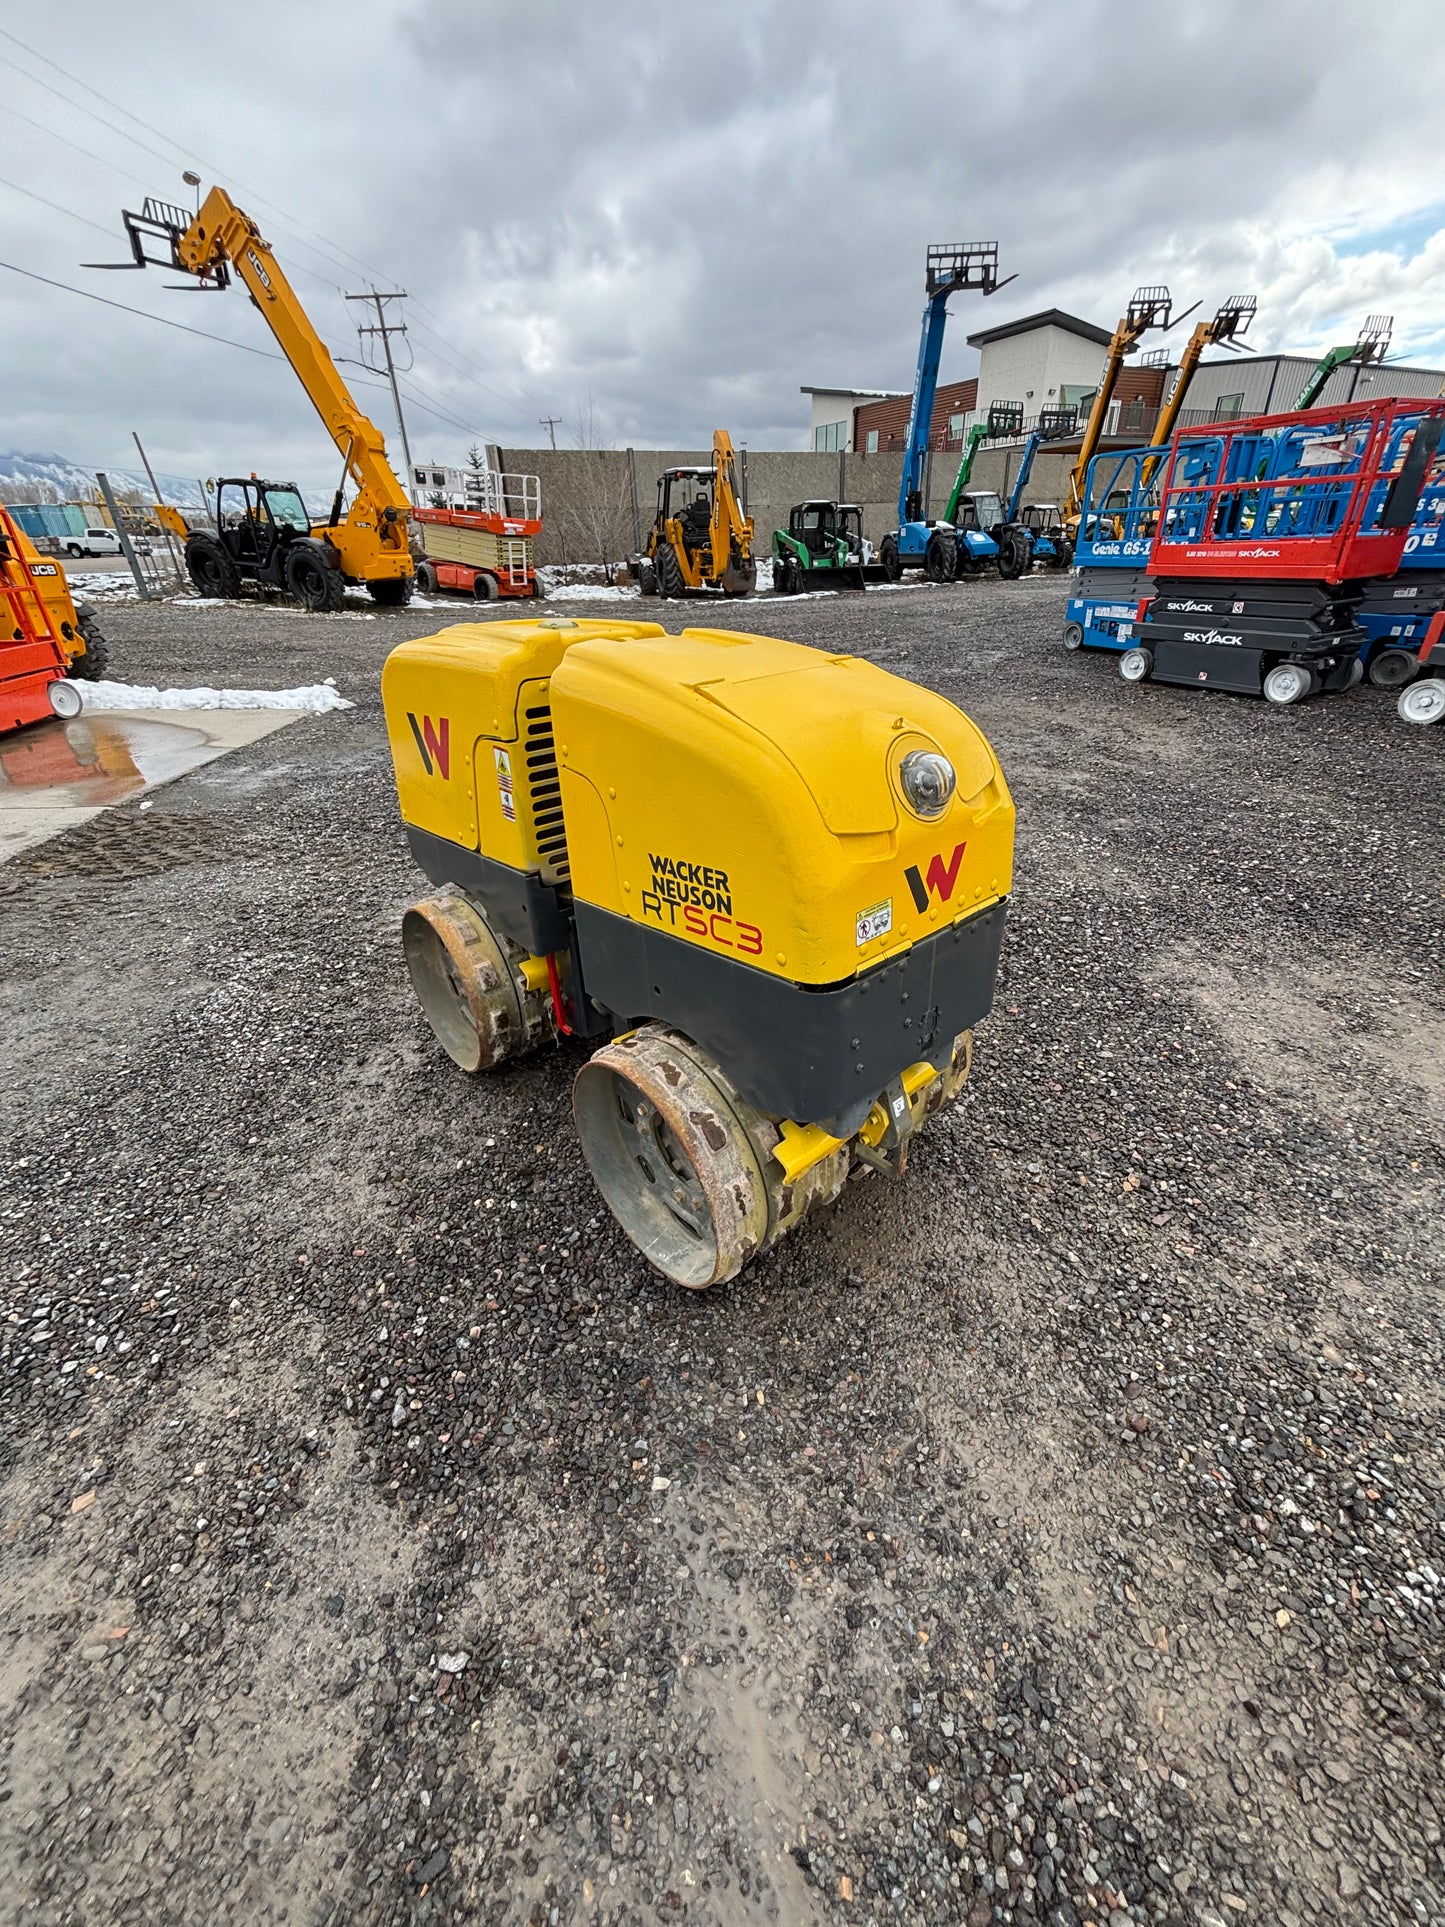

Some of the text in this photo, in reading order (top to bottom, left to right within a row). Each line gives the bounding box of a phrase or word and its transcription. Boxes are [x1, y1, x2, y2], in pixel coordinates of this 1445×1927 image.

[247, 246, 271, 289] JCB
[1097, 357, 1112, 398] JCB
[1166, 367, 1184, 406] JCB
[1091, 542, 1121, 556] Genie
[1237, 547, 1280, 558] SKYJACK
[31, 565, 57, 576] JCB
[1166, 600, 1213, 612] SKYJACK
[1183, 629, 1243, 646] SKYJACK
[648, 852, 731, 894] WACKER
[652, 874, 733, 917] NEUSON
